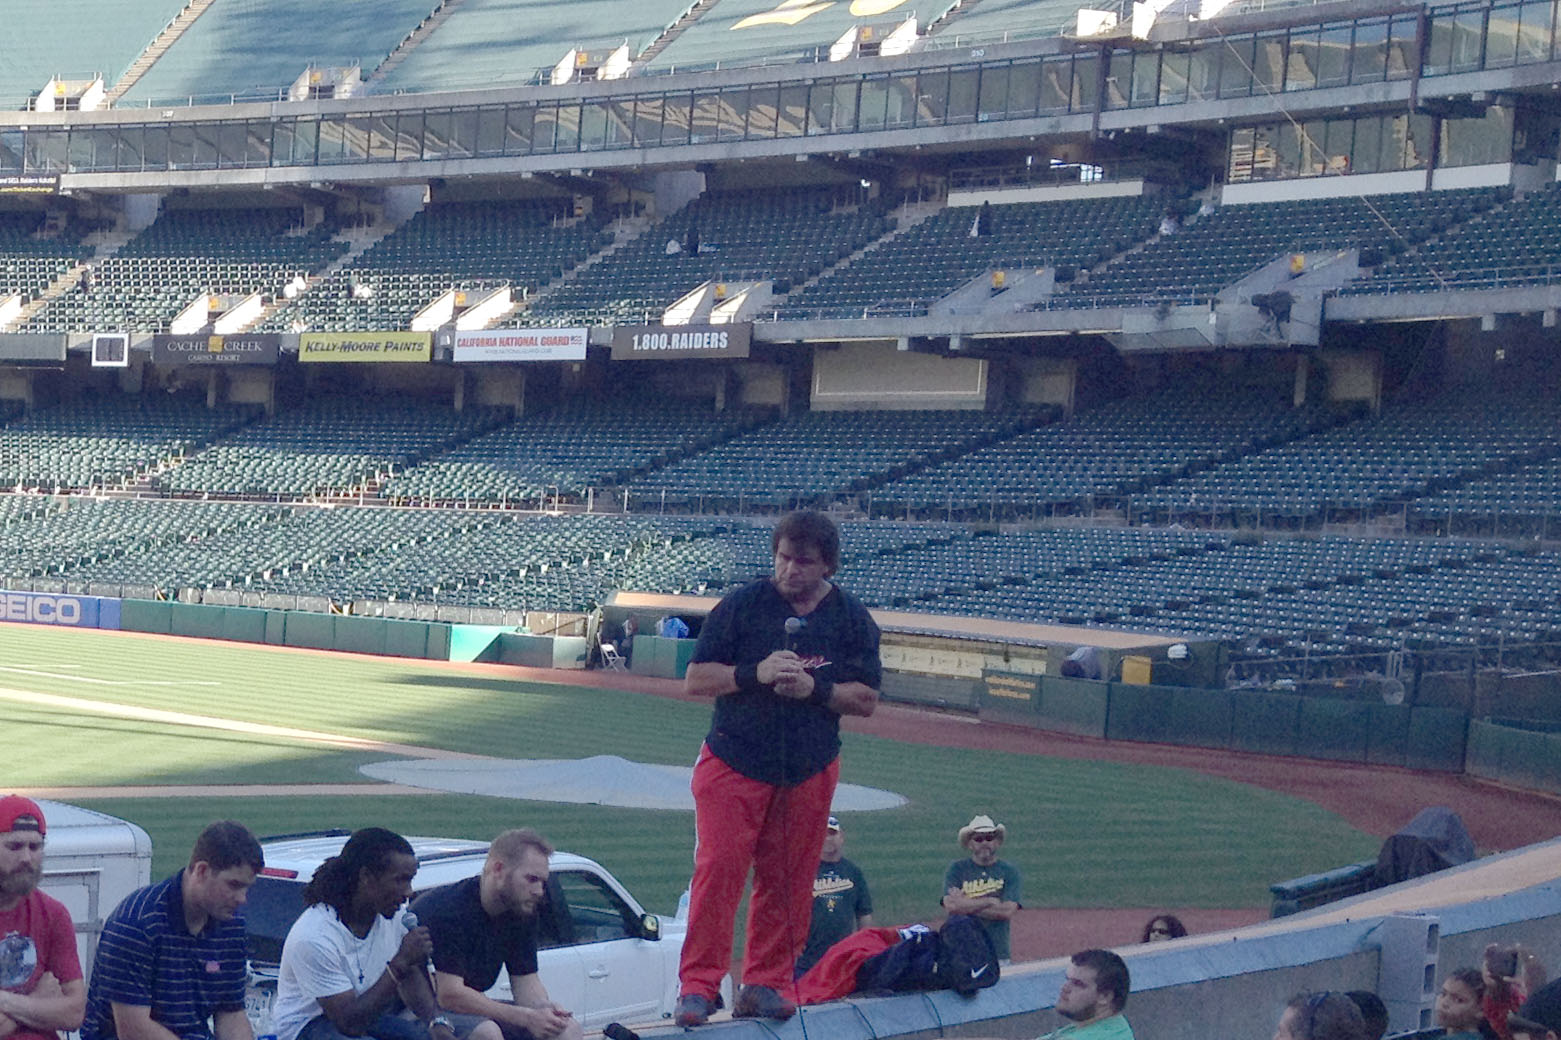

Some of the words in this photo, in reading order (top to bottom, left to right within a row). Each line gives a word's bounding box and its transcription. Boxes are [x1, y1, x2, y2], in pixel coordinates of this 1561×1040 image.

[166, 341, 207, 352] CACHE
[223, 341, 263, 352] CREEK
[456, 338, 498, 348] CALIFORNIA
[498, 336, 539, 347] NATIONAL
[540, 335, 570, 346] GUARD
[631, 331, 729, 351] 1.800.RAIDERS
